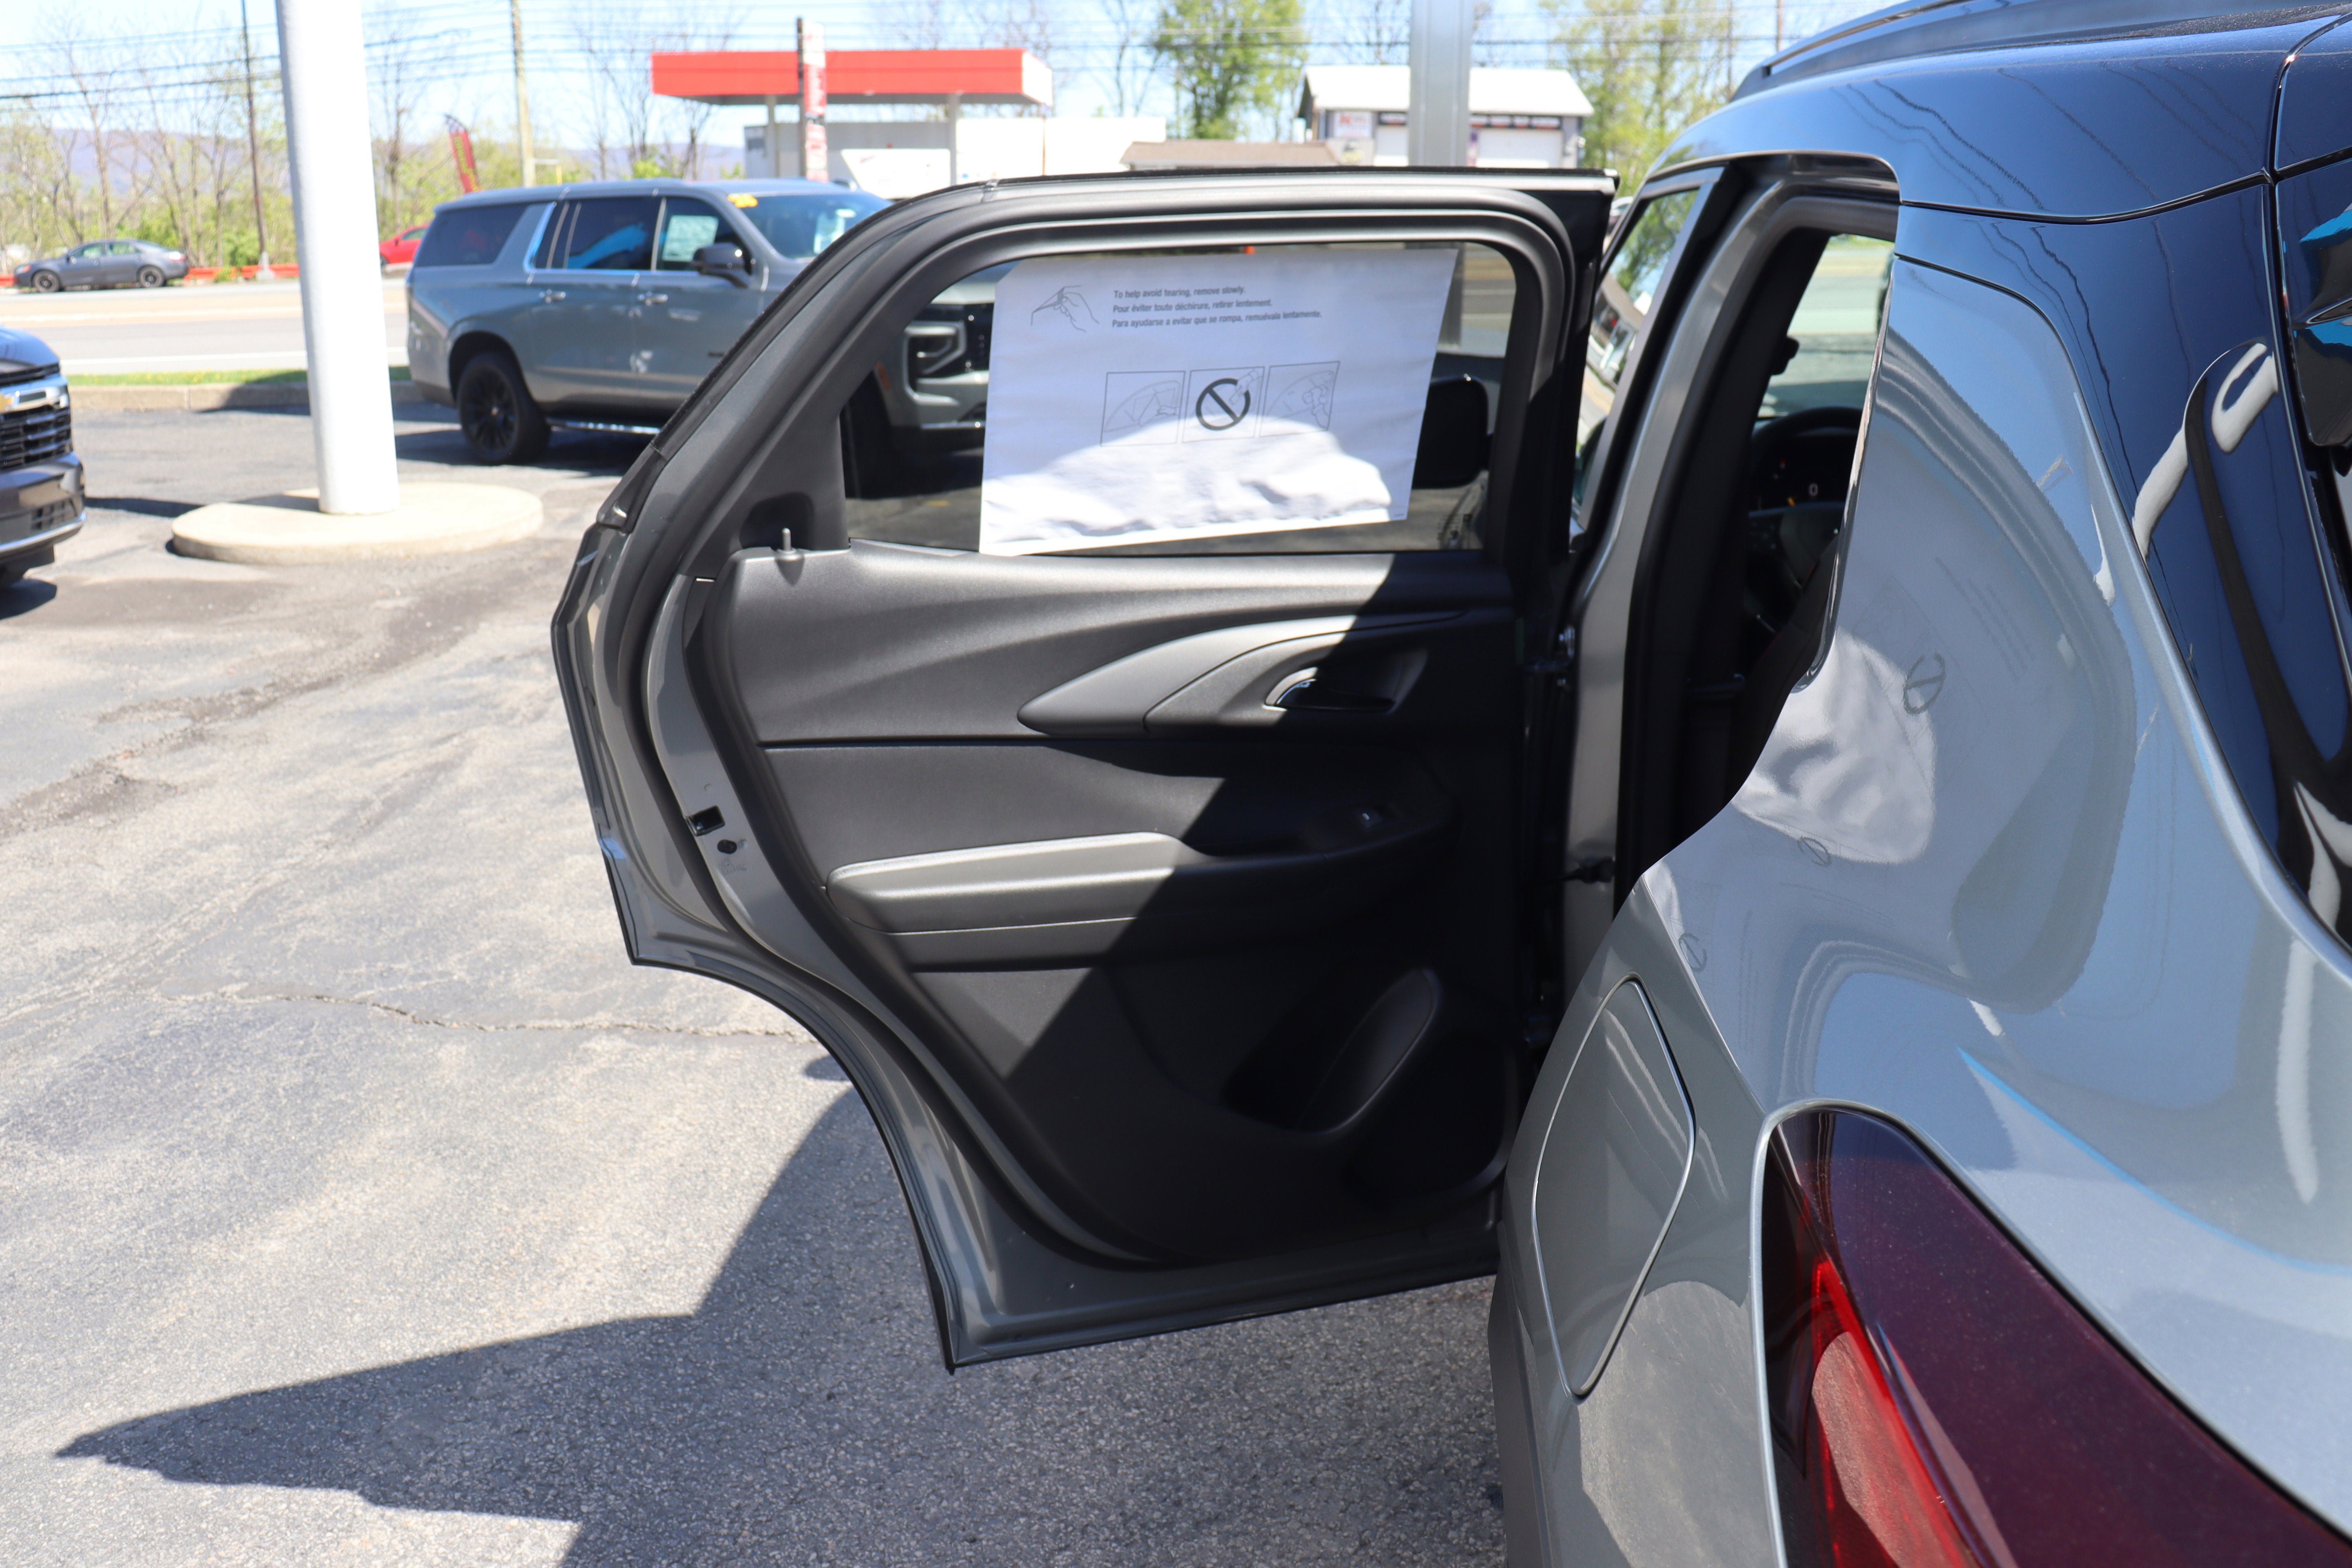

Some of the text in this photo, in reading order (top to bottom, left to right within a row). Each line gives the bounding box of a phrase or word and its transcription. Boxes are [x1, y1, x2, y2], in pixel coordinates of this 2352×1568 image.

[1125, 290, 1140, 298] help
[1143, 289, 1162, 297] avoid
[1164, 288, 1191, 297] tearing,
[1222, 286, 1245, 294] slowly.
[1130, 318, 1163, 327] ayudarse
